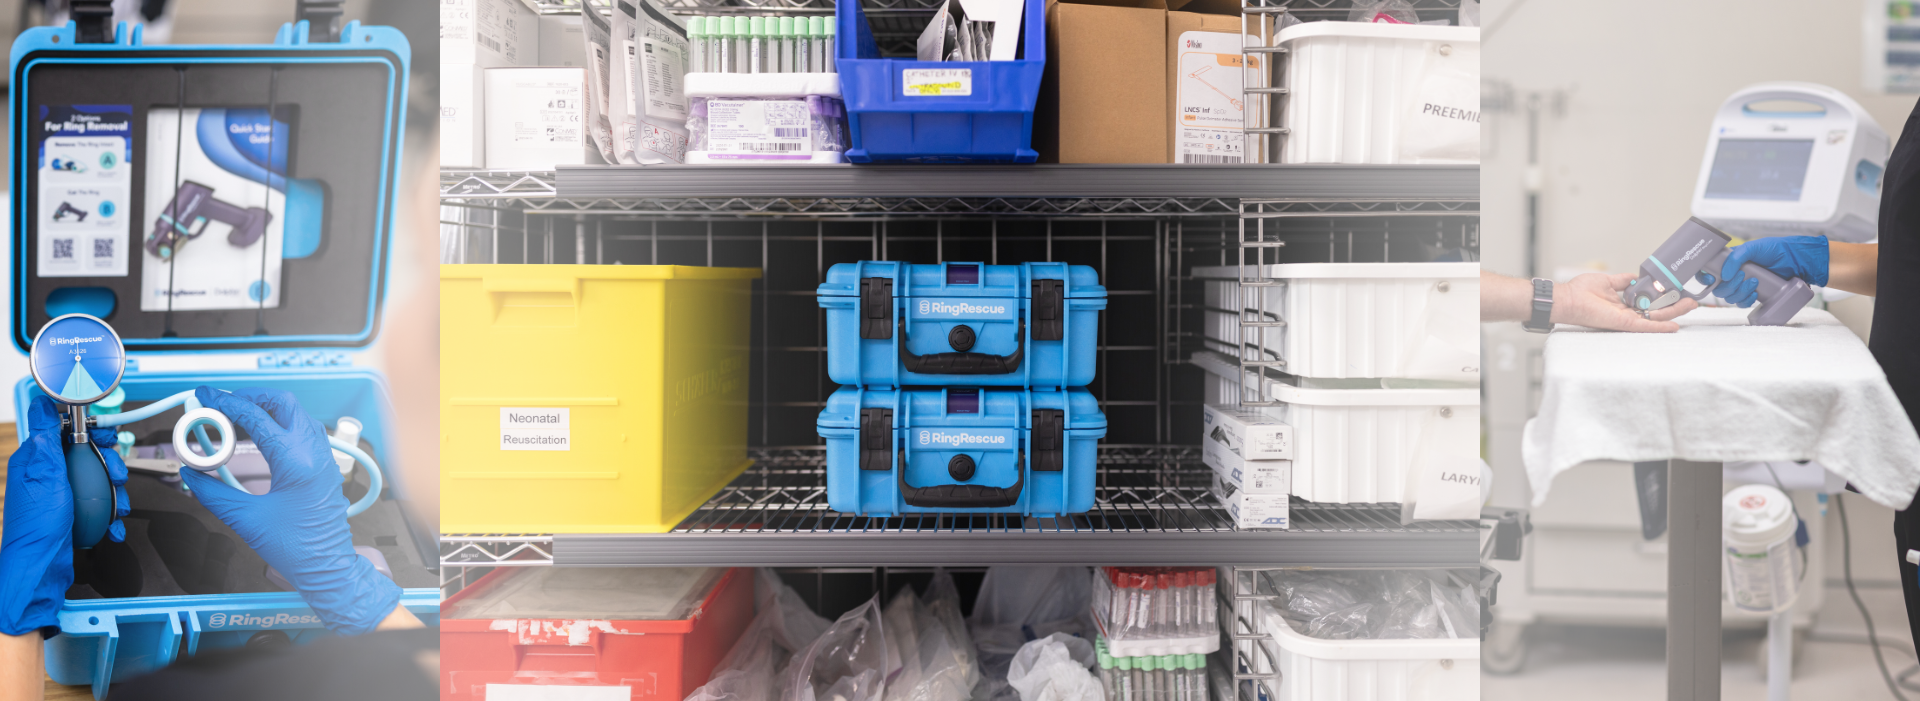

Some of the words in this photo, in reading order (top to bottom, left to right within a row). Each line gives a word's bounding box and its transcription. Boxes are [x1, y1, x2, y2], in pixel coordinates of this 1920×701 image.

[45, 122, 62, 132] For
[64, 122, 85, 134] Ring
[87, 120, 128, 131] Removal
[230, 123, 253, 134] Quick
[104, 156, 112, 165] A
[1675, 239, 1705, 266] RingRescue
[932, 302, 1005, 316] RingRescue
[57, 336, 103, 346] RingRescue
[509, 412, 560, 424] Neonatal
[503, 434, 567, 444] Reuscitation
[932, 432, 1005, 446] RingRescue
[228, 614, 321, 628] RingResc
